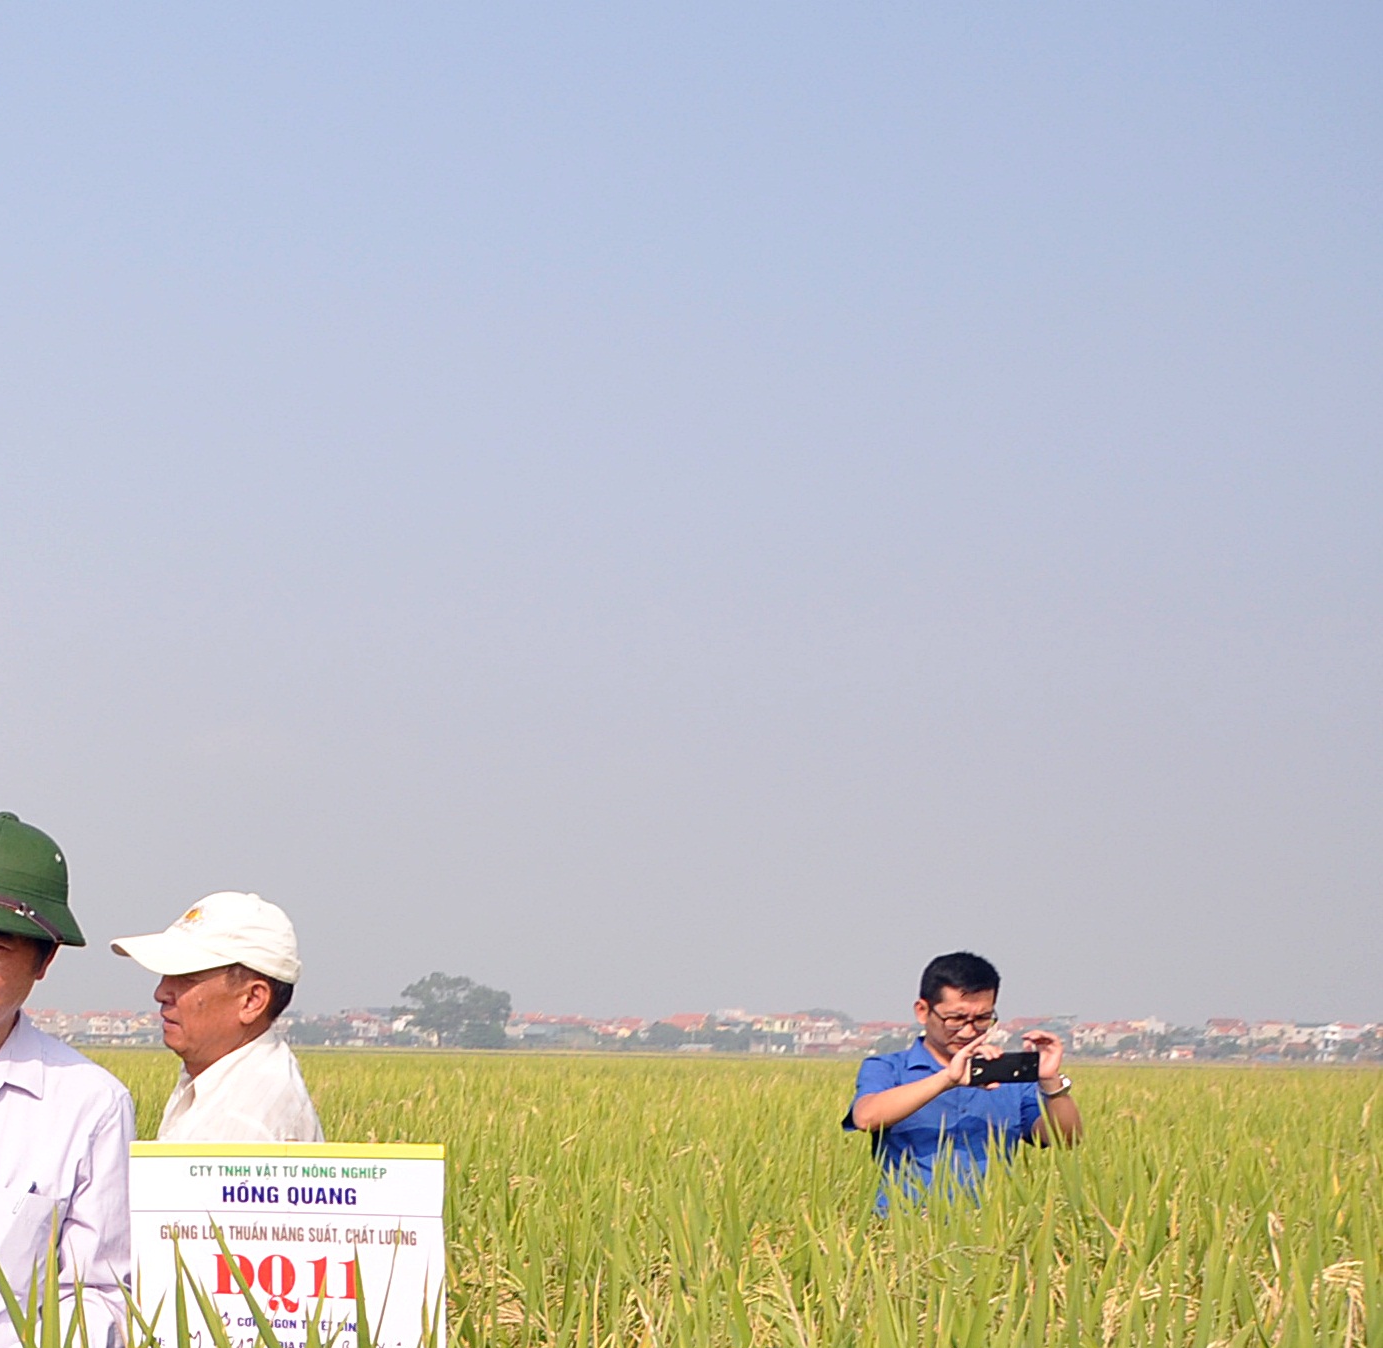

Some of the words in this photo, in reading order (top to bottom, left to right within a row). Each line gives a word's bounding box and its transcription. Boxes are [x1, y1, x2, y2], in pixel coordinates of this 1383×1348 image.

[189, 1164, 213, 1177] CTY
[218, 1165, 252, 1178] TNHH
[255, 1163, 278, 1180] VẬT
[301, 1163, 337, 1179] NÔNG
[287, 1186, 357, 1206] QUANG
[212, 1253, 300, 1313] DQ
[306, 1255, 357, 1300] 11
